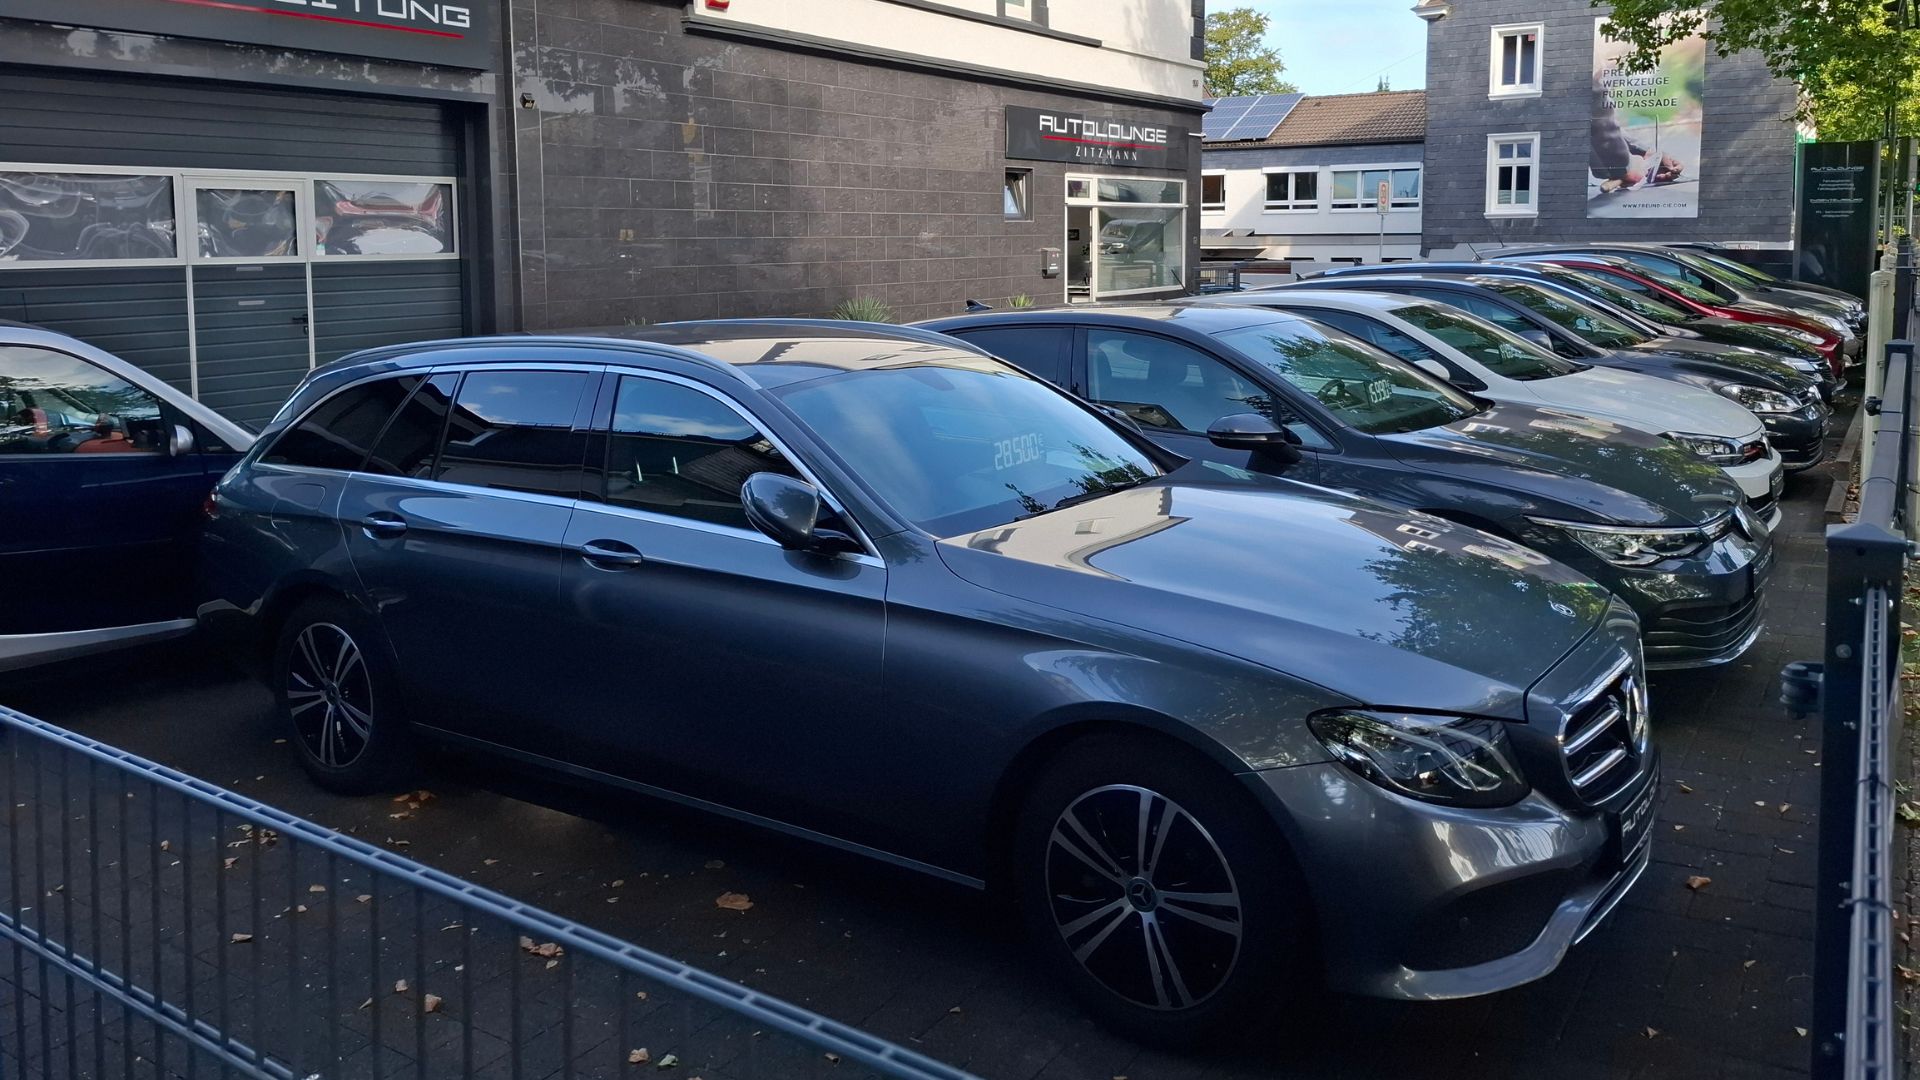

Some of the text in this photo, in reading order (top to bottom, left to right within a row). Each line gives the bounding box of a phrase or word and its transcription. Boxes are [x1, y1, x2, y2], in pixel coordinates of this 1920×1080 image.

[1603, 68, 1660, 77] PREIUM-
[1603, 77, 1669, 88] WERKZEUGE
[1626, 88, 1657, 98] DACH
[1602, 98, 1678, 110] UND FASSADE
[1039, 115, 1167, 143] AUTOLOUNGE
[1075, 145, 1138, 161] ZITZMANN
